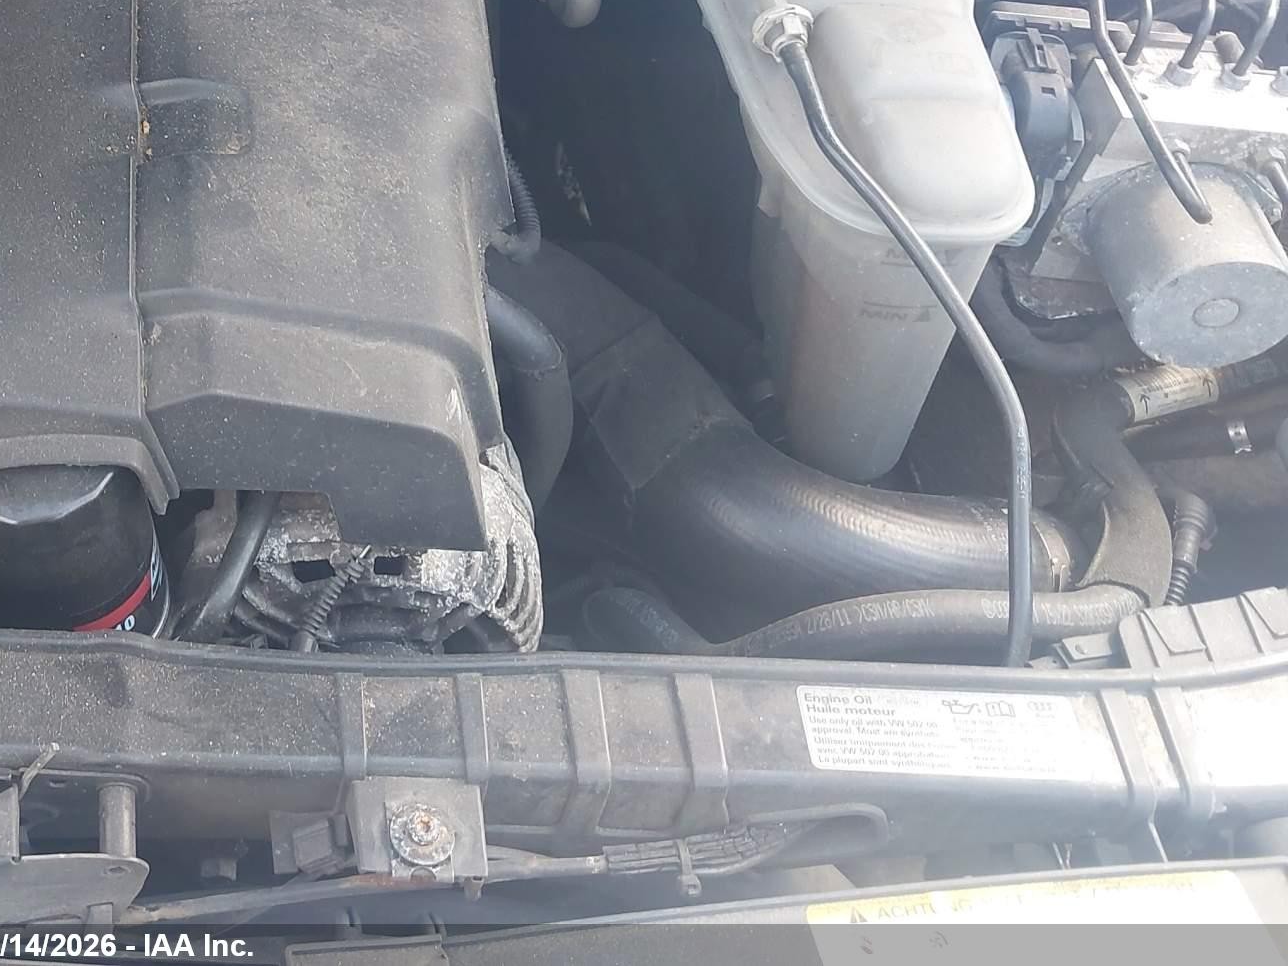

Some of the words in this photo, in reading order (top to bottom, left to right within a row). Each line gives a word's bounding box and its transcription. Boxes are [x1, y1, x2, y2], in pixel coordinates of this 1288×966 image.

[803, 692, 850, 705] Engine
[853, 695, 873, 705] Oil
[806, 703, 841, 715] Huile
[843, 707, 897, 717] moteur
